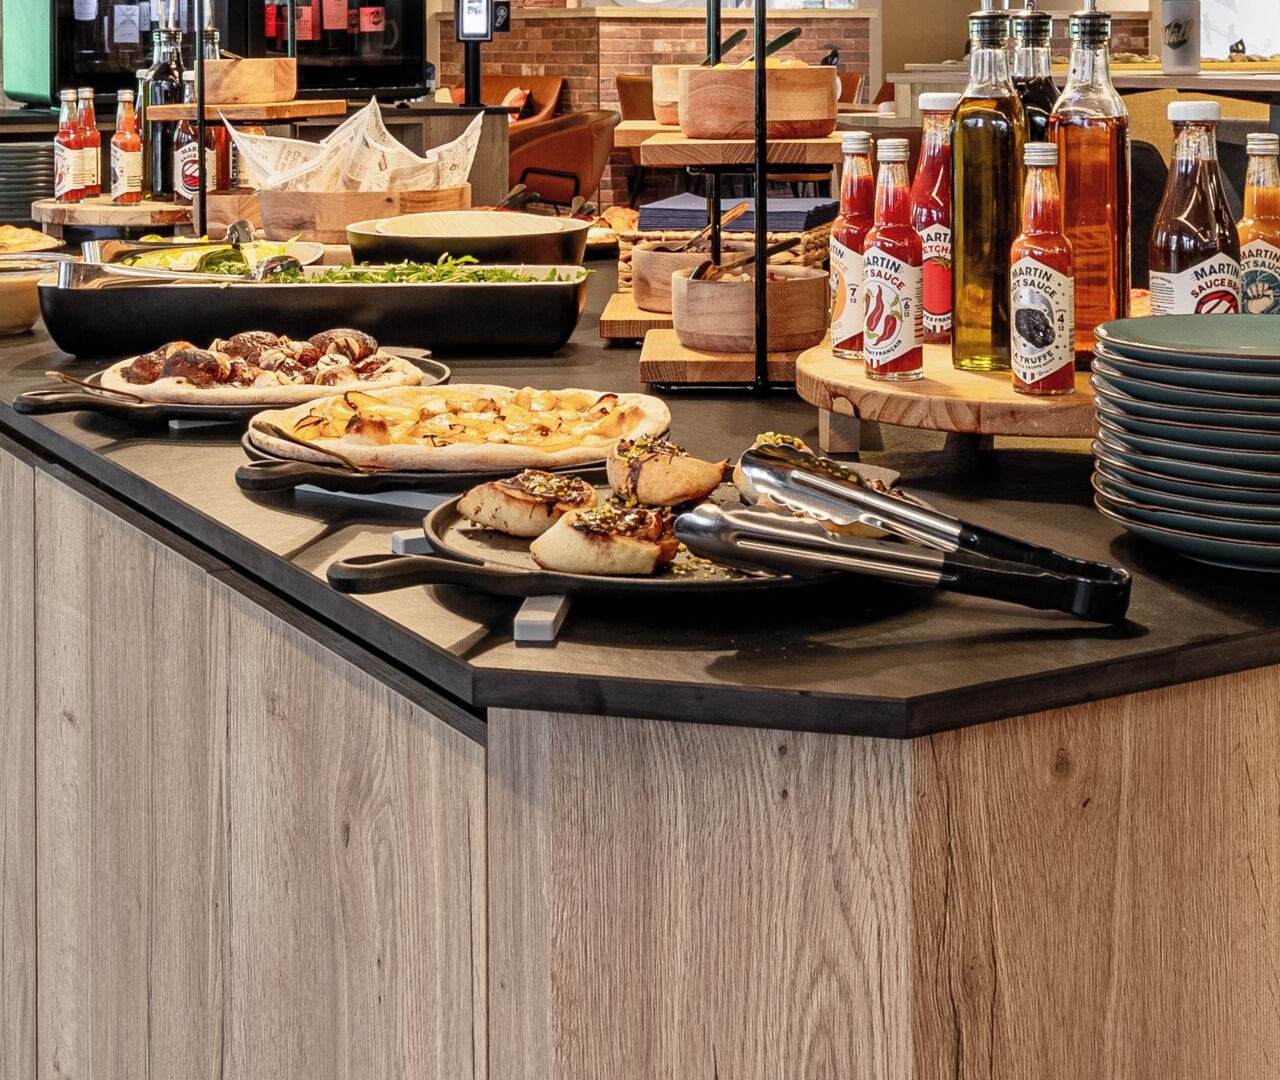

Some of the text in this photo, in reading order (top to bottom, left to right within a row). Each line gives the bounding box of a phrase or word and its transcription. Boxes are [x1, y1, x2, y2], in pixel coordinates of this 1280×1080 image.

[922, 245, 952, 255] ETCH
[1240, 260, 1251, 272] OT
[870, 268, 906, 291] SAUCE
[1012, 266, 1053, 282] MARTIN
[850, 288, 857, 297] 7
[1023, 278, 1057, 299] SAUCE
[1190, 278, 1226, 299] SAUCE
[903, 301, 910, 310] 6
[1057, 313, 1065, 324] 4
[1019, 349, 1055, 365] TRUFFE
